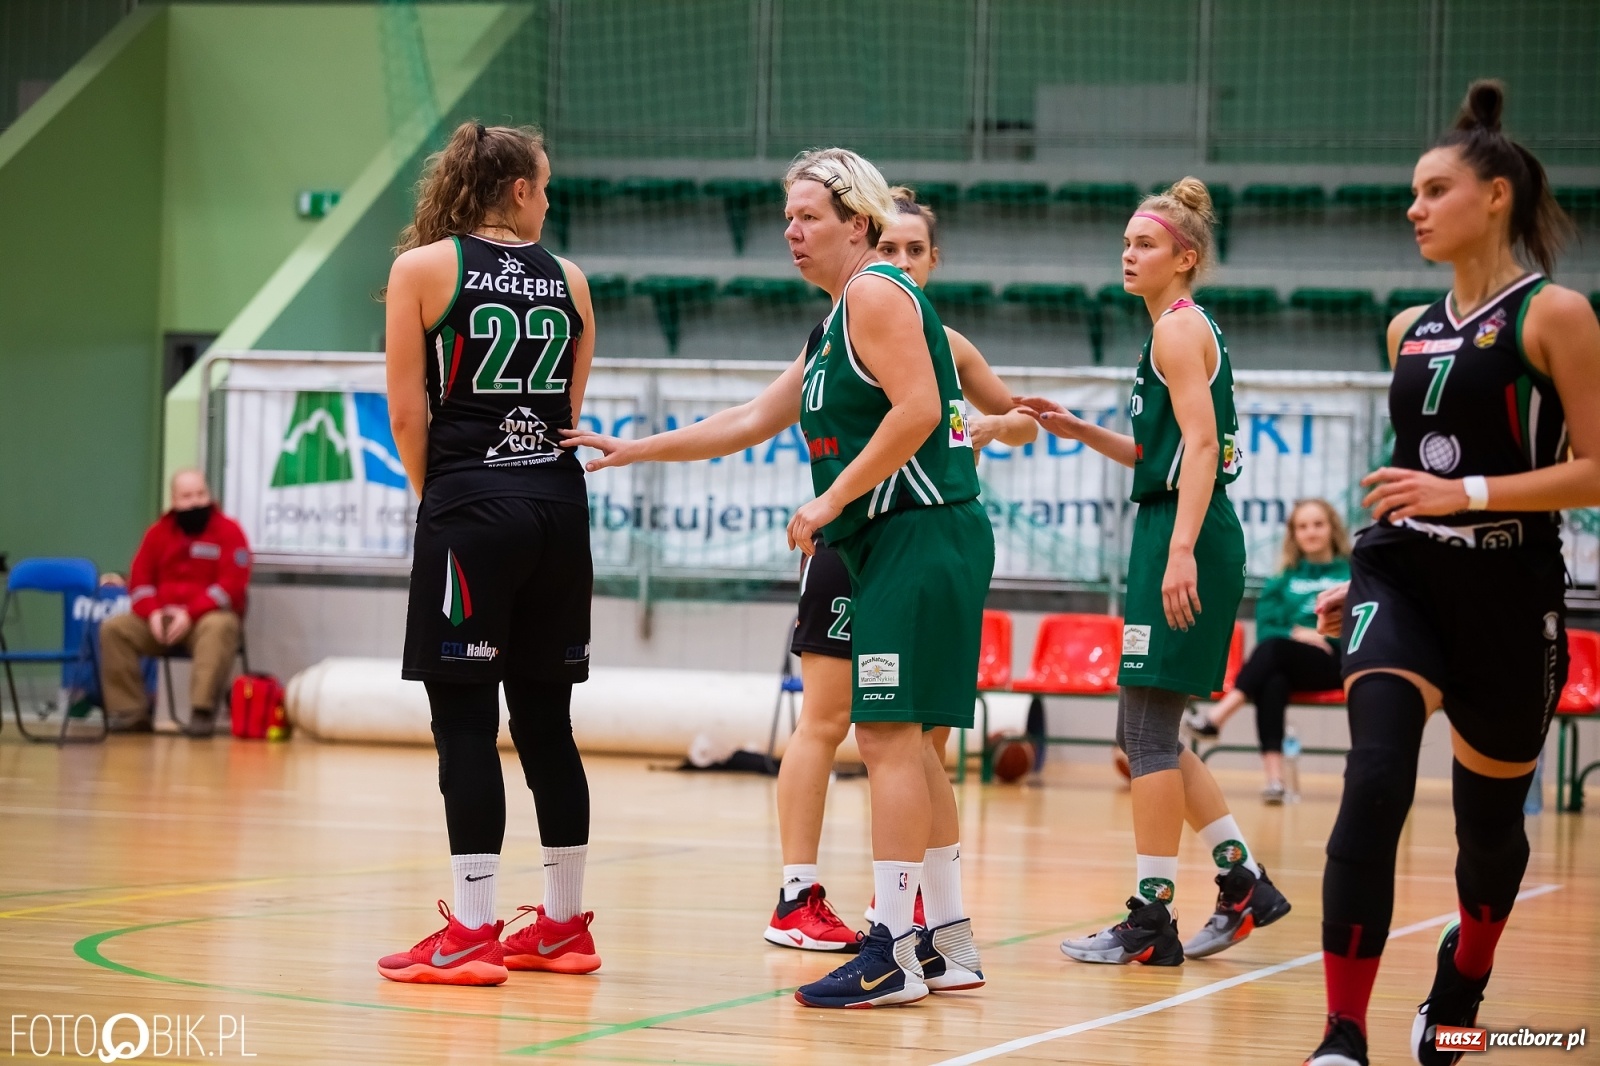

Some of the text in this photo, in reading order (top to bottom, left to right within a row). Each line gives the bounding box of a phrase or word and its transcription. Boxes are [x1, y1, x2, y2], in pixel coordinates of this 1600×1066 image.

[464, 270, 567, 301] ZAGŁĘBIE
[469, 303, 572, 394] 22
[1421, 354, 1456, 415] 7
[504, 418, 540, 433] MY
[507, 432, 545, 453] GO!
[588, 494, 791, 542] ibicujem
[1347, 601, 1380, 655] 7
[440, 640, 497, 661] CTL Haldex
[862, 693, 896, 701] COLO
